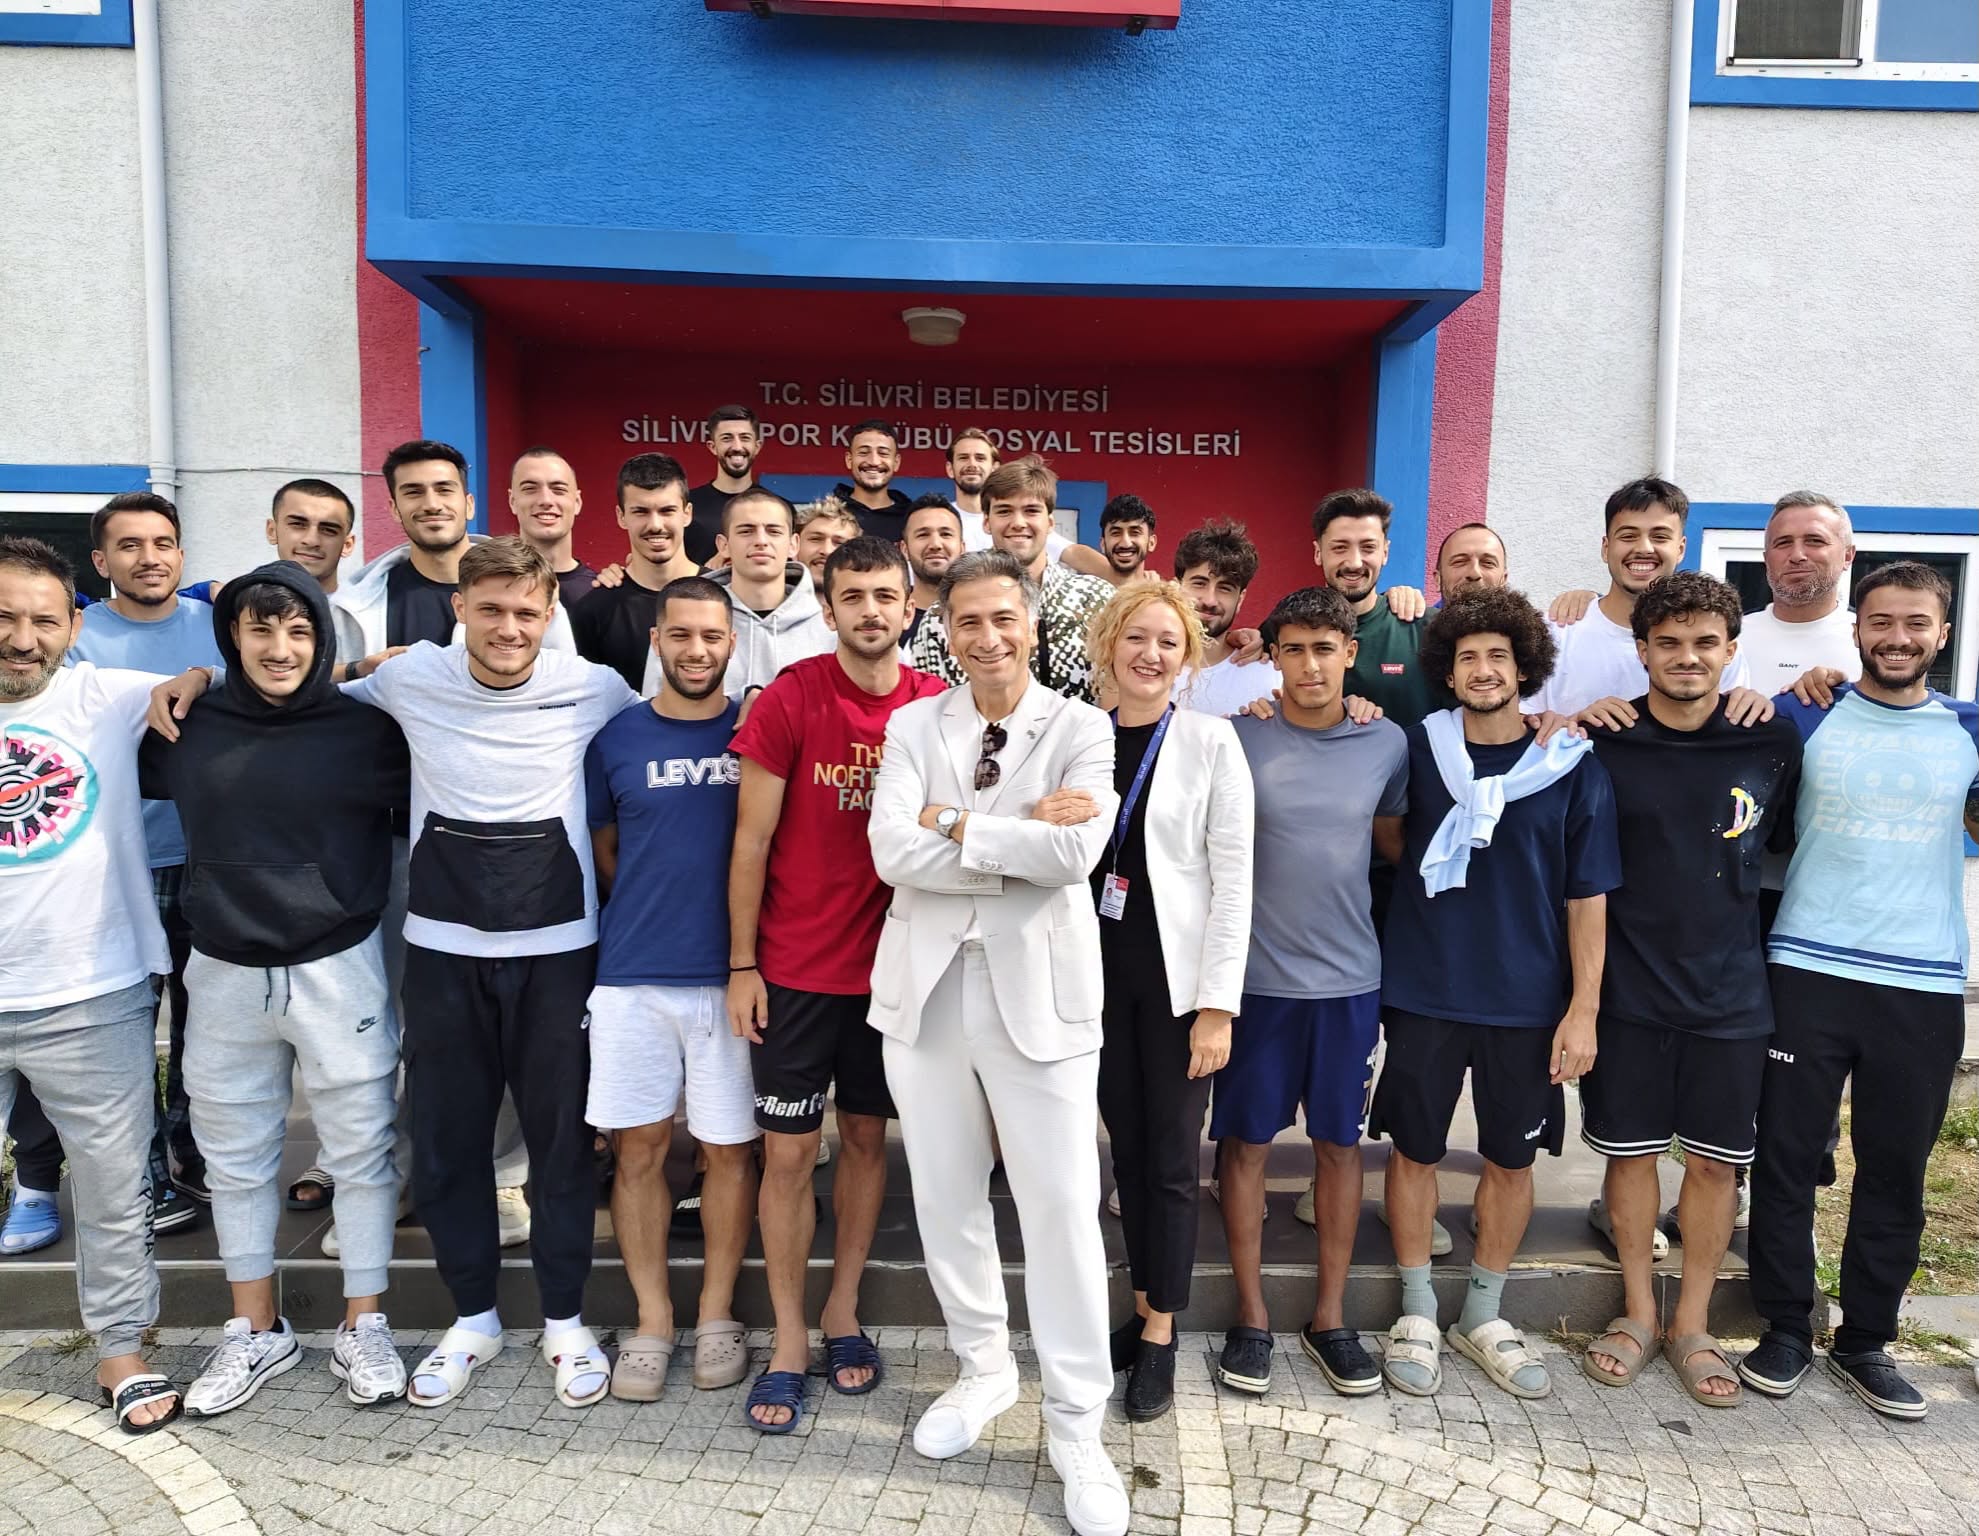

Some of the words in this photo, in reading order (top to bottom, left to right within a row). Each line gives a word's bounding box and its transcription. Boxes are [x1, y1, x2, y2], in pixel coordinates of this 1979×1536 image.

[759, 381, 808, 405] T.C.
[819, 378, 922, 408] SİLİVRİ
[933, 384, 1109, 413] BELEDİYESİ
[622, 414, 821, 446] SİLİVPOR
[831, 421, 953, 450] KÜBÜ
[985, 428, 1081, 452] OSYAL
[1090, 427, 1241, 457] TESİSLERİ
[850, 742, 883, 767] TH
[813, 762, 880, 788] NORT
[838, 788, 876, 811] FAC
[1768, 1048, 1795, 1063] aru
[676, 1196, 701, 1209] PUM
